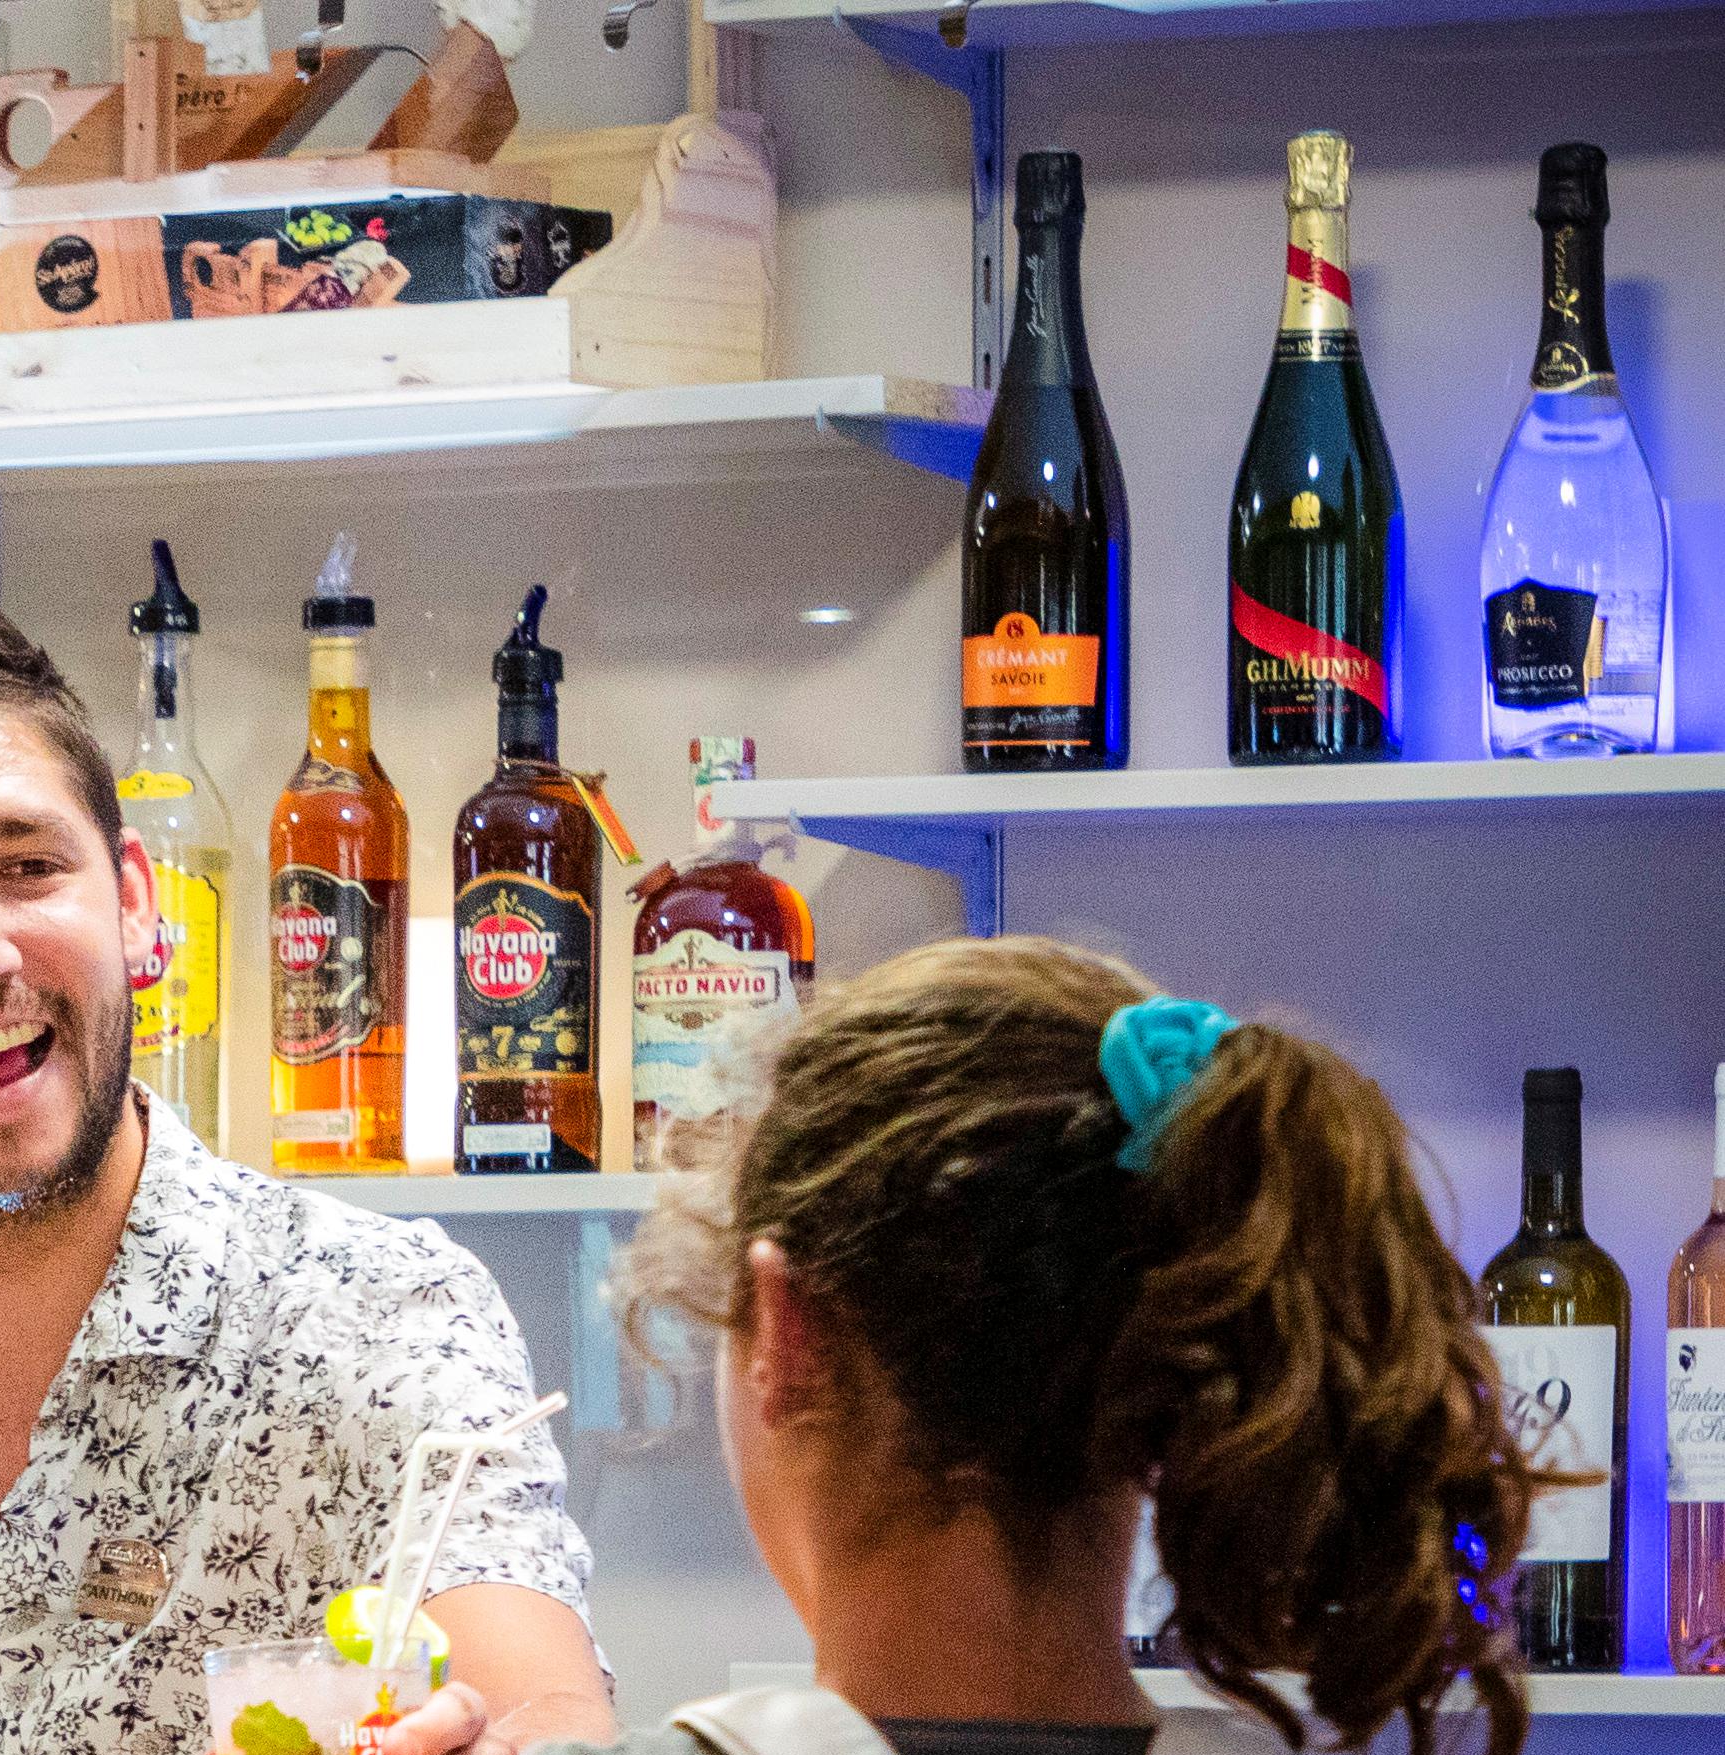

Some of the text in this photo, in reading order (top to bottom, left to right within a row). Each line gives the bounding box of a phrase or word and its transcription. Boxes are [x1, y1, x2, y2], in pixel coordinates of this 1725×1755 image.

[977, 644, 1069, 669] CRÉMANT
[991, 671, 1048, 687] SAVOIE
[278, 937, 319, 964] Club
[459, 926, 557, 956] Havana
[472, 957, 534, 986] Club
[637, 974, 766, 997] PACTO NAVIO
[88, 1585, 159, 1608] ANTHONY
